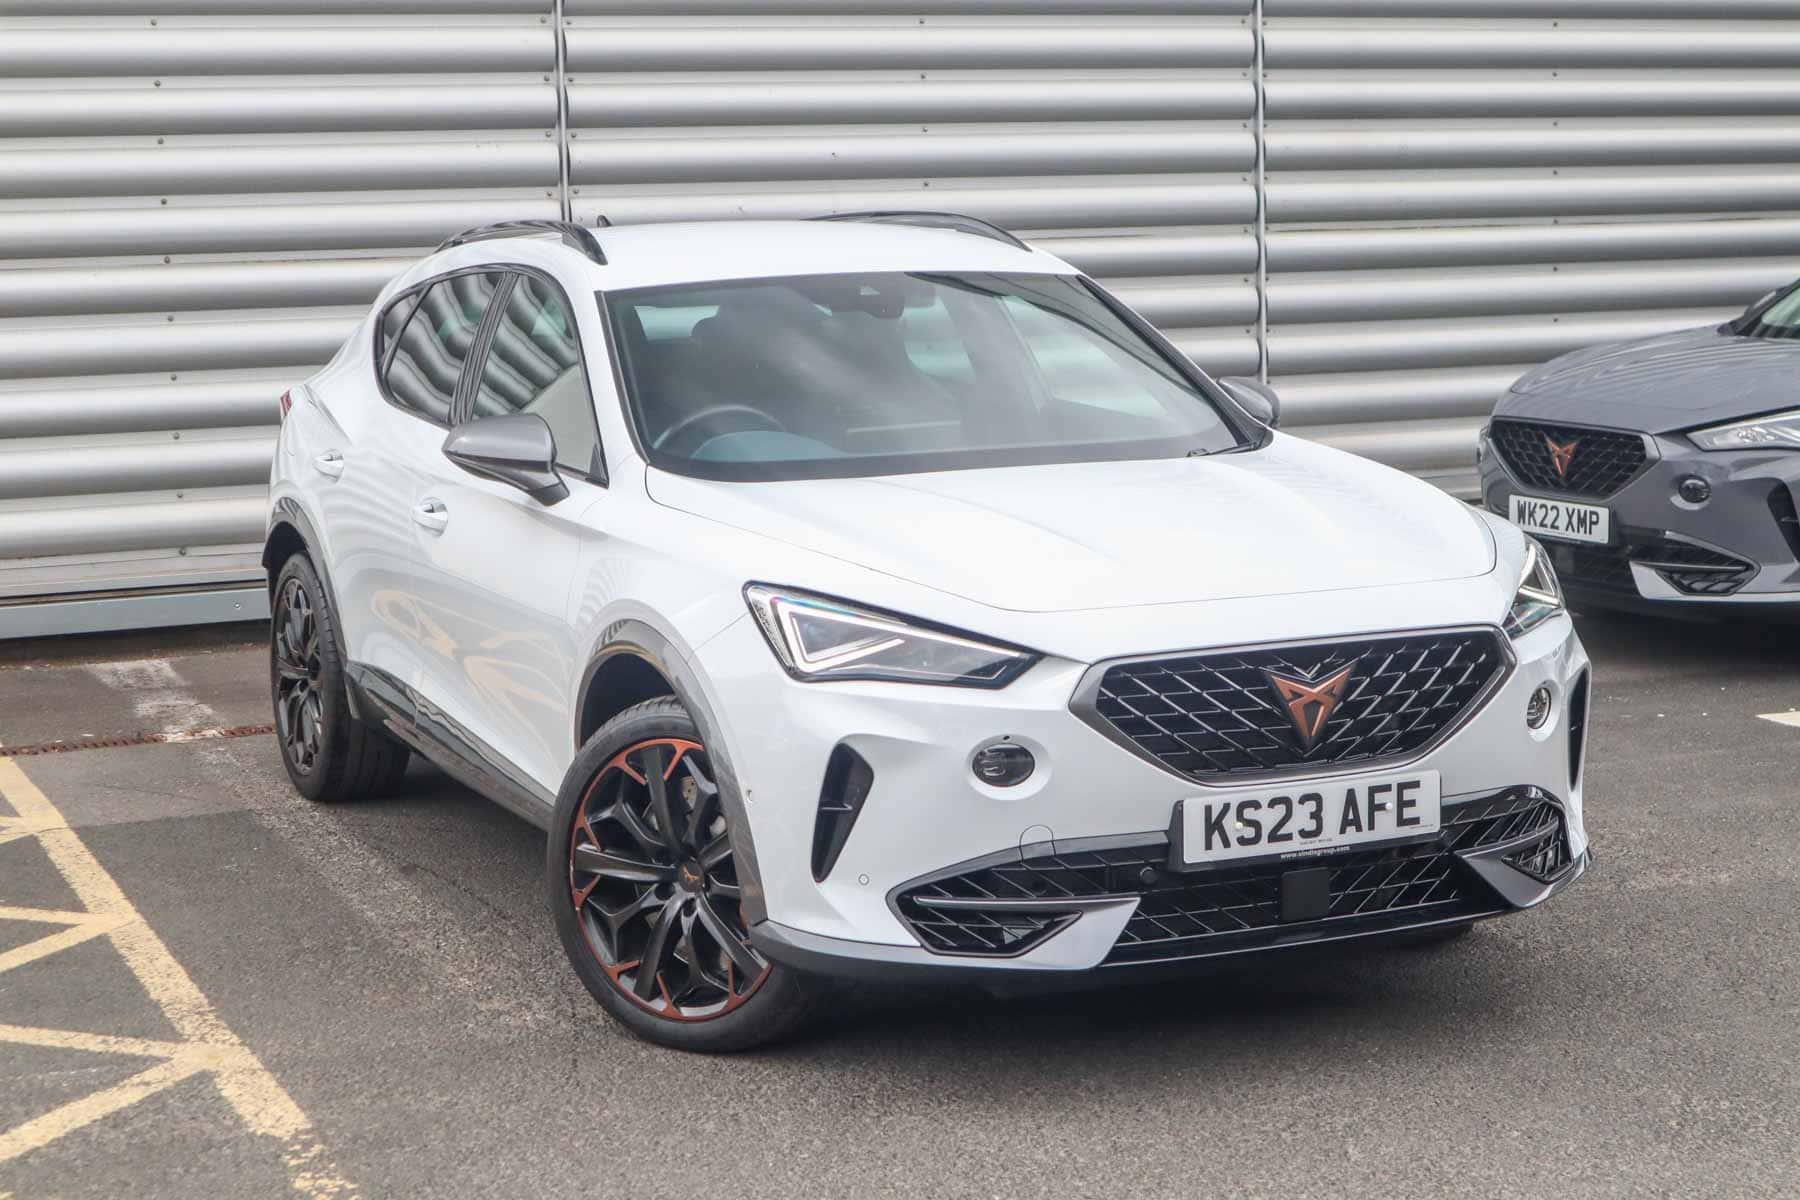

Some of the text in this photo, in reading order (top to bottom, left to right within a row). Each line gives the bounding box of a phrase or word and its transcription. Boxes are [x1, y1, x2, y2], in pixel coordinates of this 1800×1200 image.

[1517, 500, 1600, 535] WK22 XMP
[1204, 780, 1421, 850] KS23 AFE
